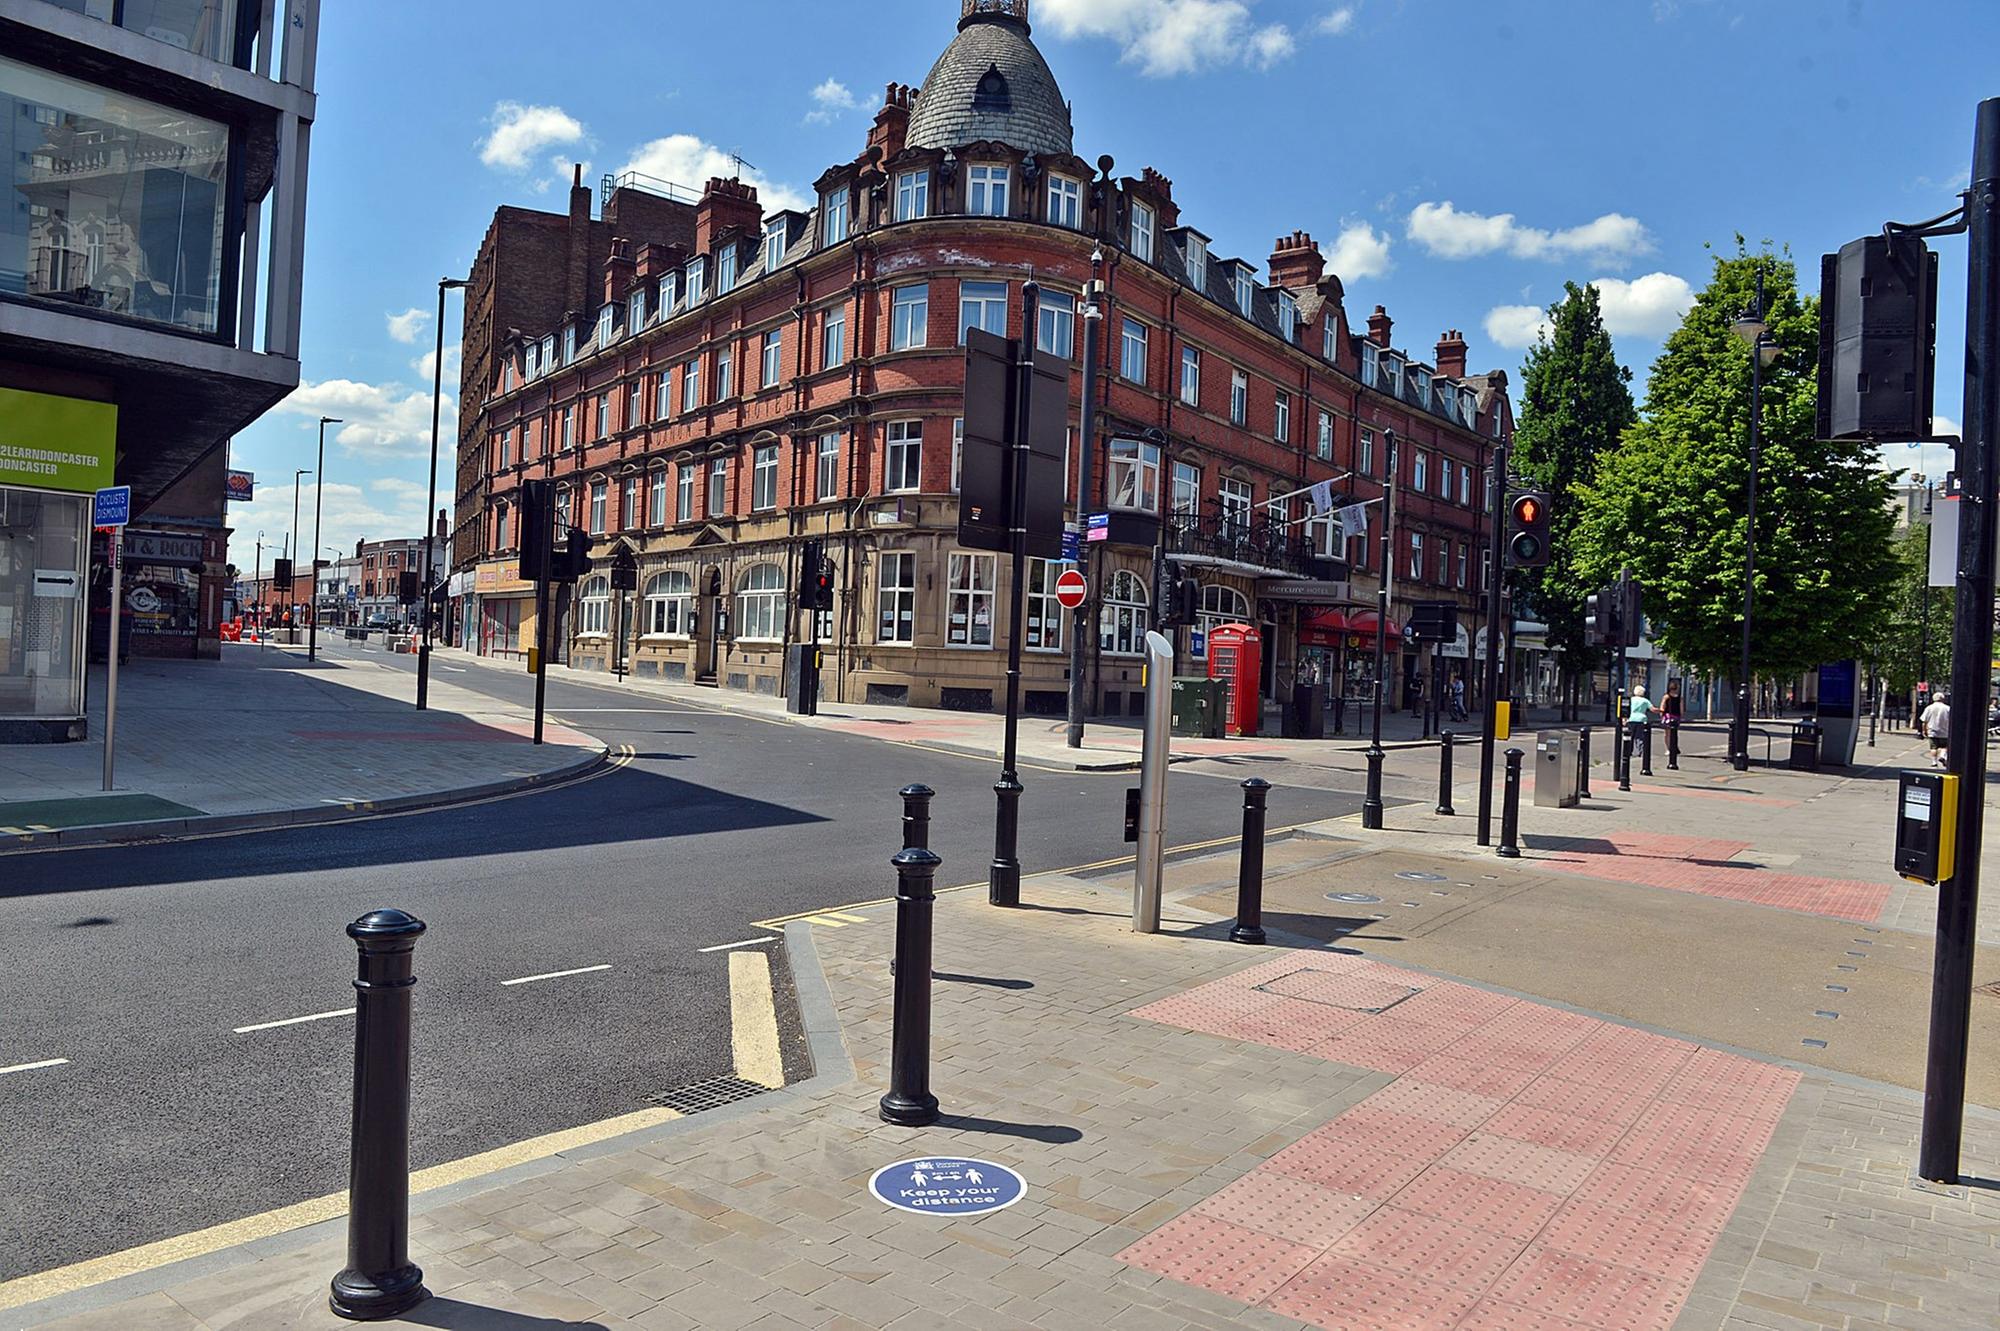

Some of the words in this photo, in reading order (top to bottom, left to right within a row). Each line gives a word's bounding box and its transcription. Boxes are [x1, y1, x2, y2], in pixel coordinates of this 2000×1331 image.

[100, 493, 125, 506] CYCLISTS
[97, 506, 127, 519] DISMOUNT
[160, 540, 201, 558] ROCK
[1267, 585, 1305, 593] Mercure
[900, 1188, 950, 1197] Keep
[955, 1187, 999, 1196] your
[912, 1197, 995, 1206] distance
